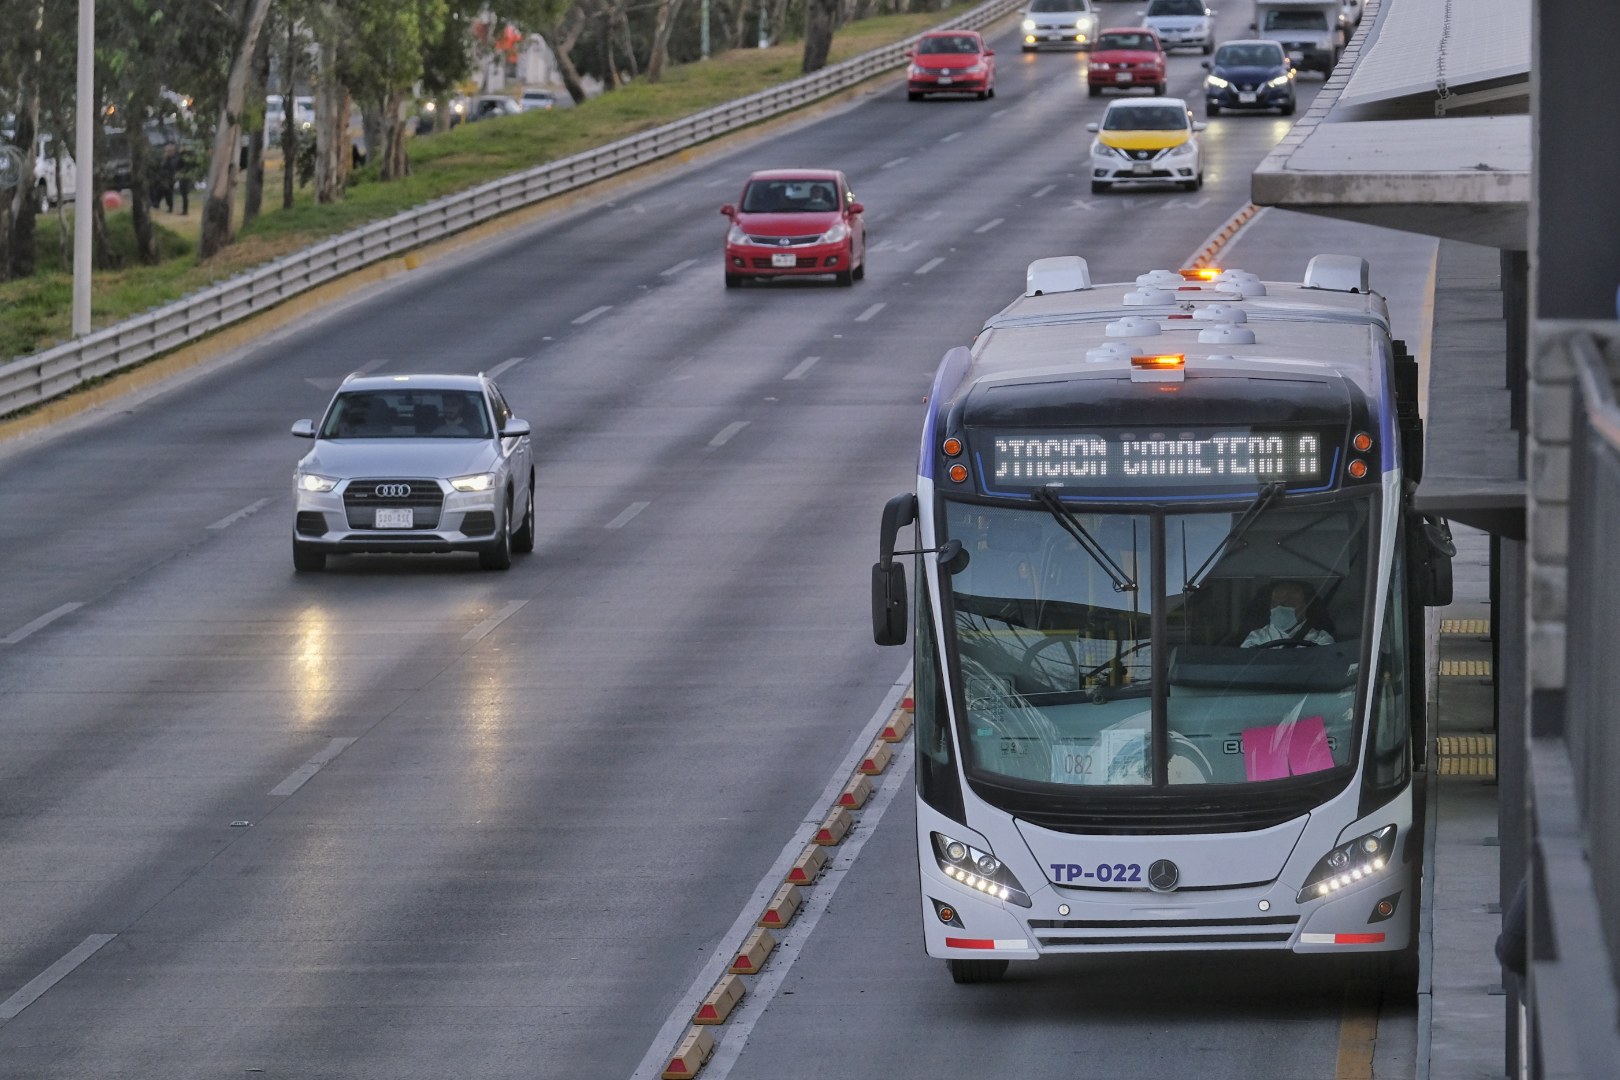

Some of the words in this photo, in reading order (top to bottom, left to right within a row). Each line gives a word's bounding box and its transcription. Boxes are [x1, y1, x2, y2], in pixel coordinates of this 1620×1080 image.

[1299, 436, 1316, 473] A
[1064, 753, 1093, 775] 082
[1050, 863, 1141, 882] TP-022
